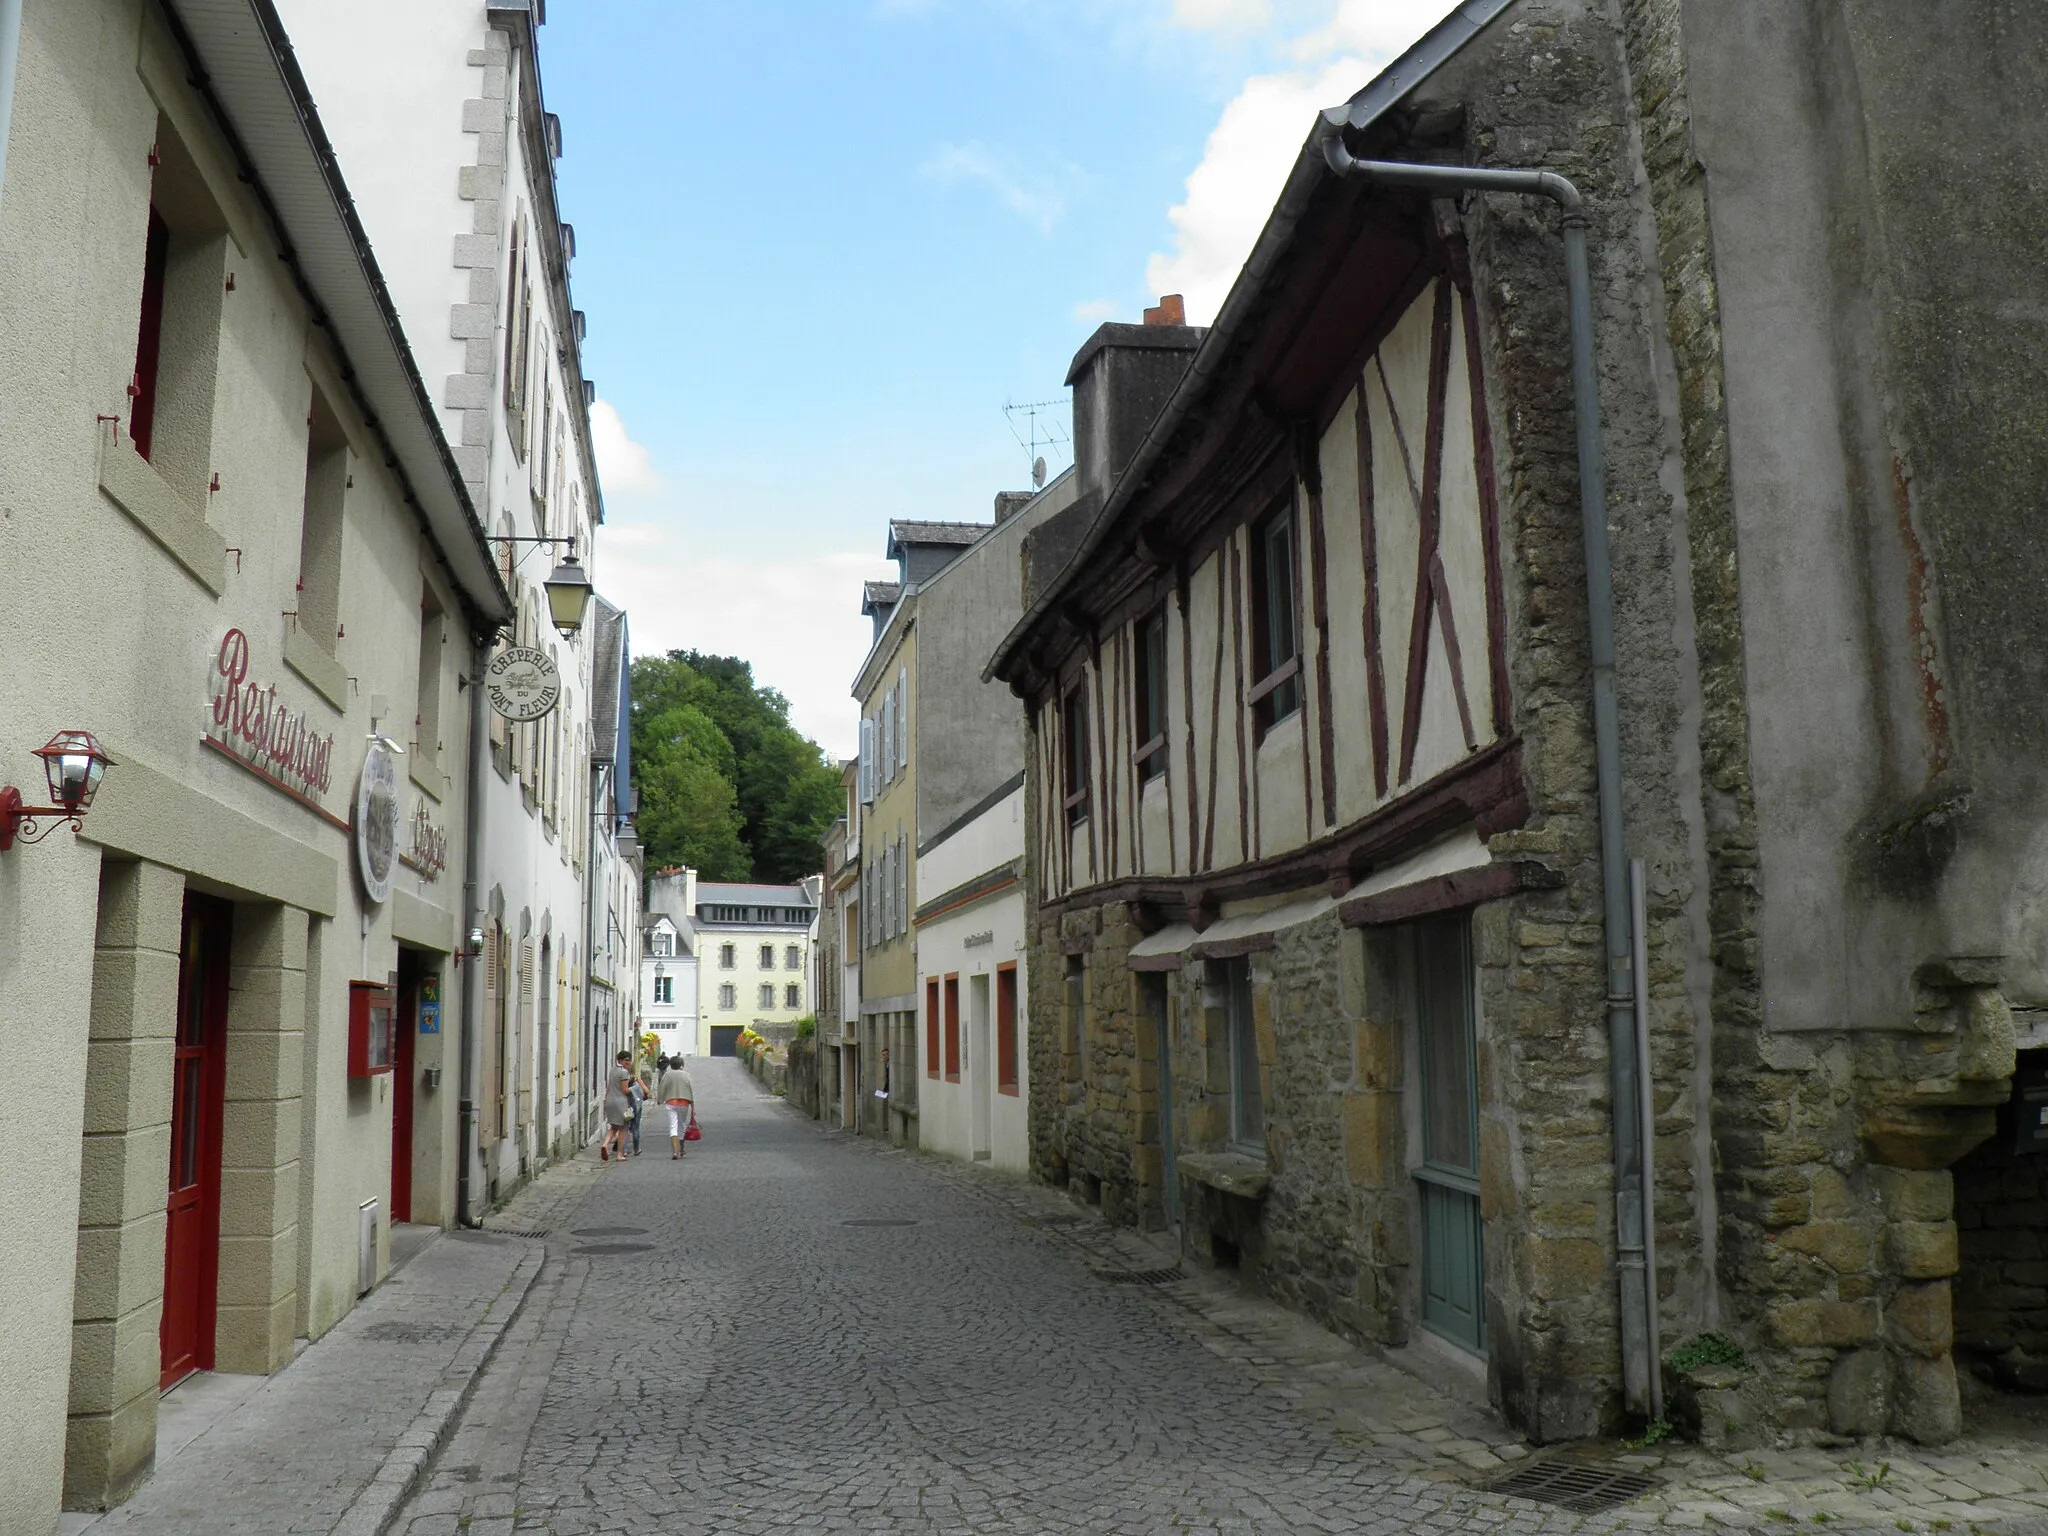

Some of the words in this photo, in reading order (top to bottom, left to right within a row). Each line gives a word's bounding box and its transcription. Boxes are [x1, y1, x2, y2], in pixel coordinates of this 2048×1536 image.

[490, 649, 555, 677] CREPERIE
[213, 628, 334, 795] Restaurant
[487, 684, 514, 713] PONT
[519, 686, 556, 717] FLEURI
